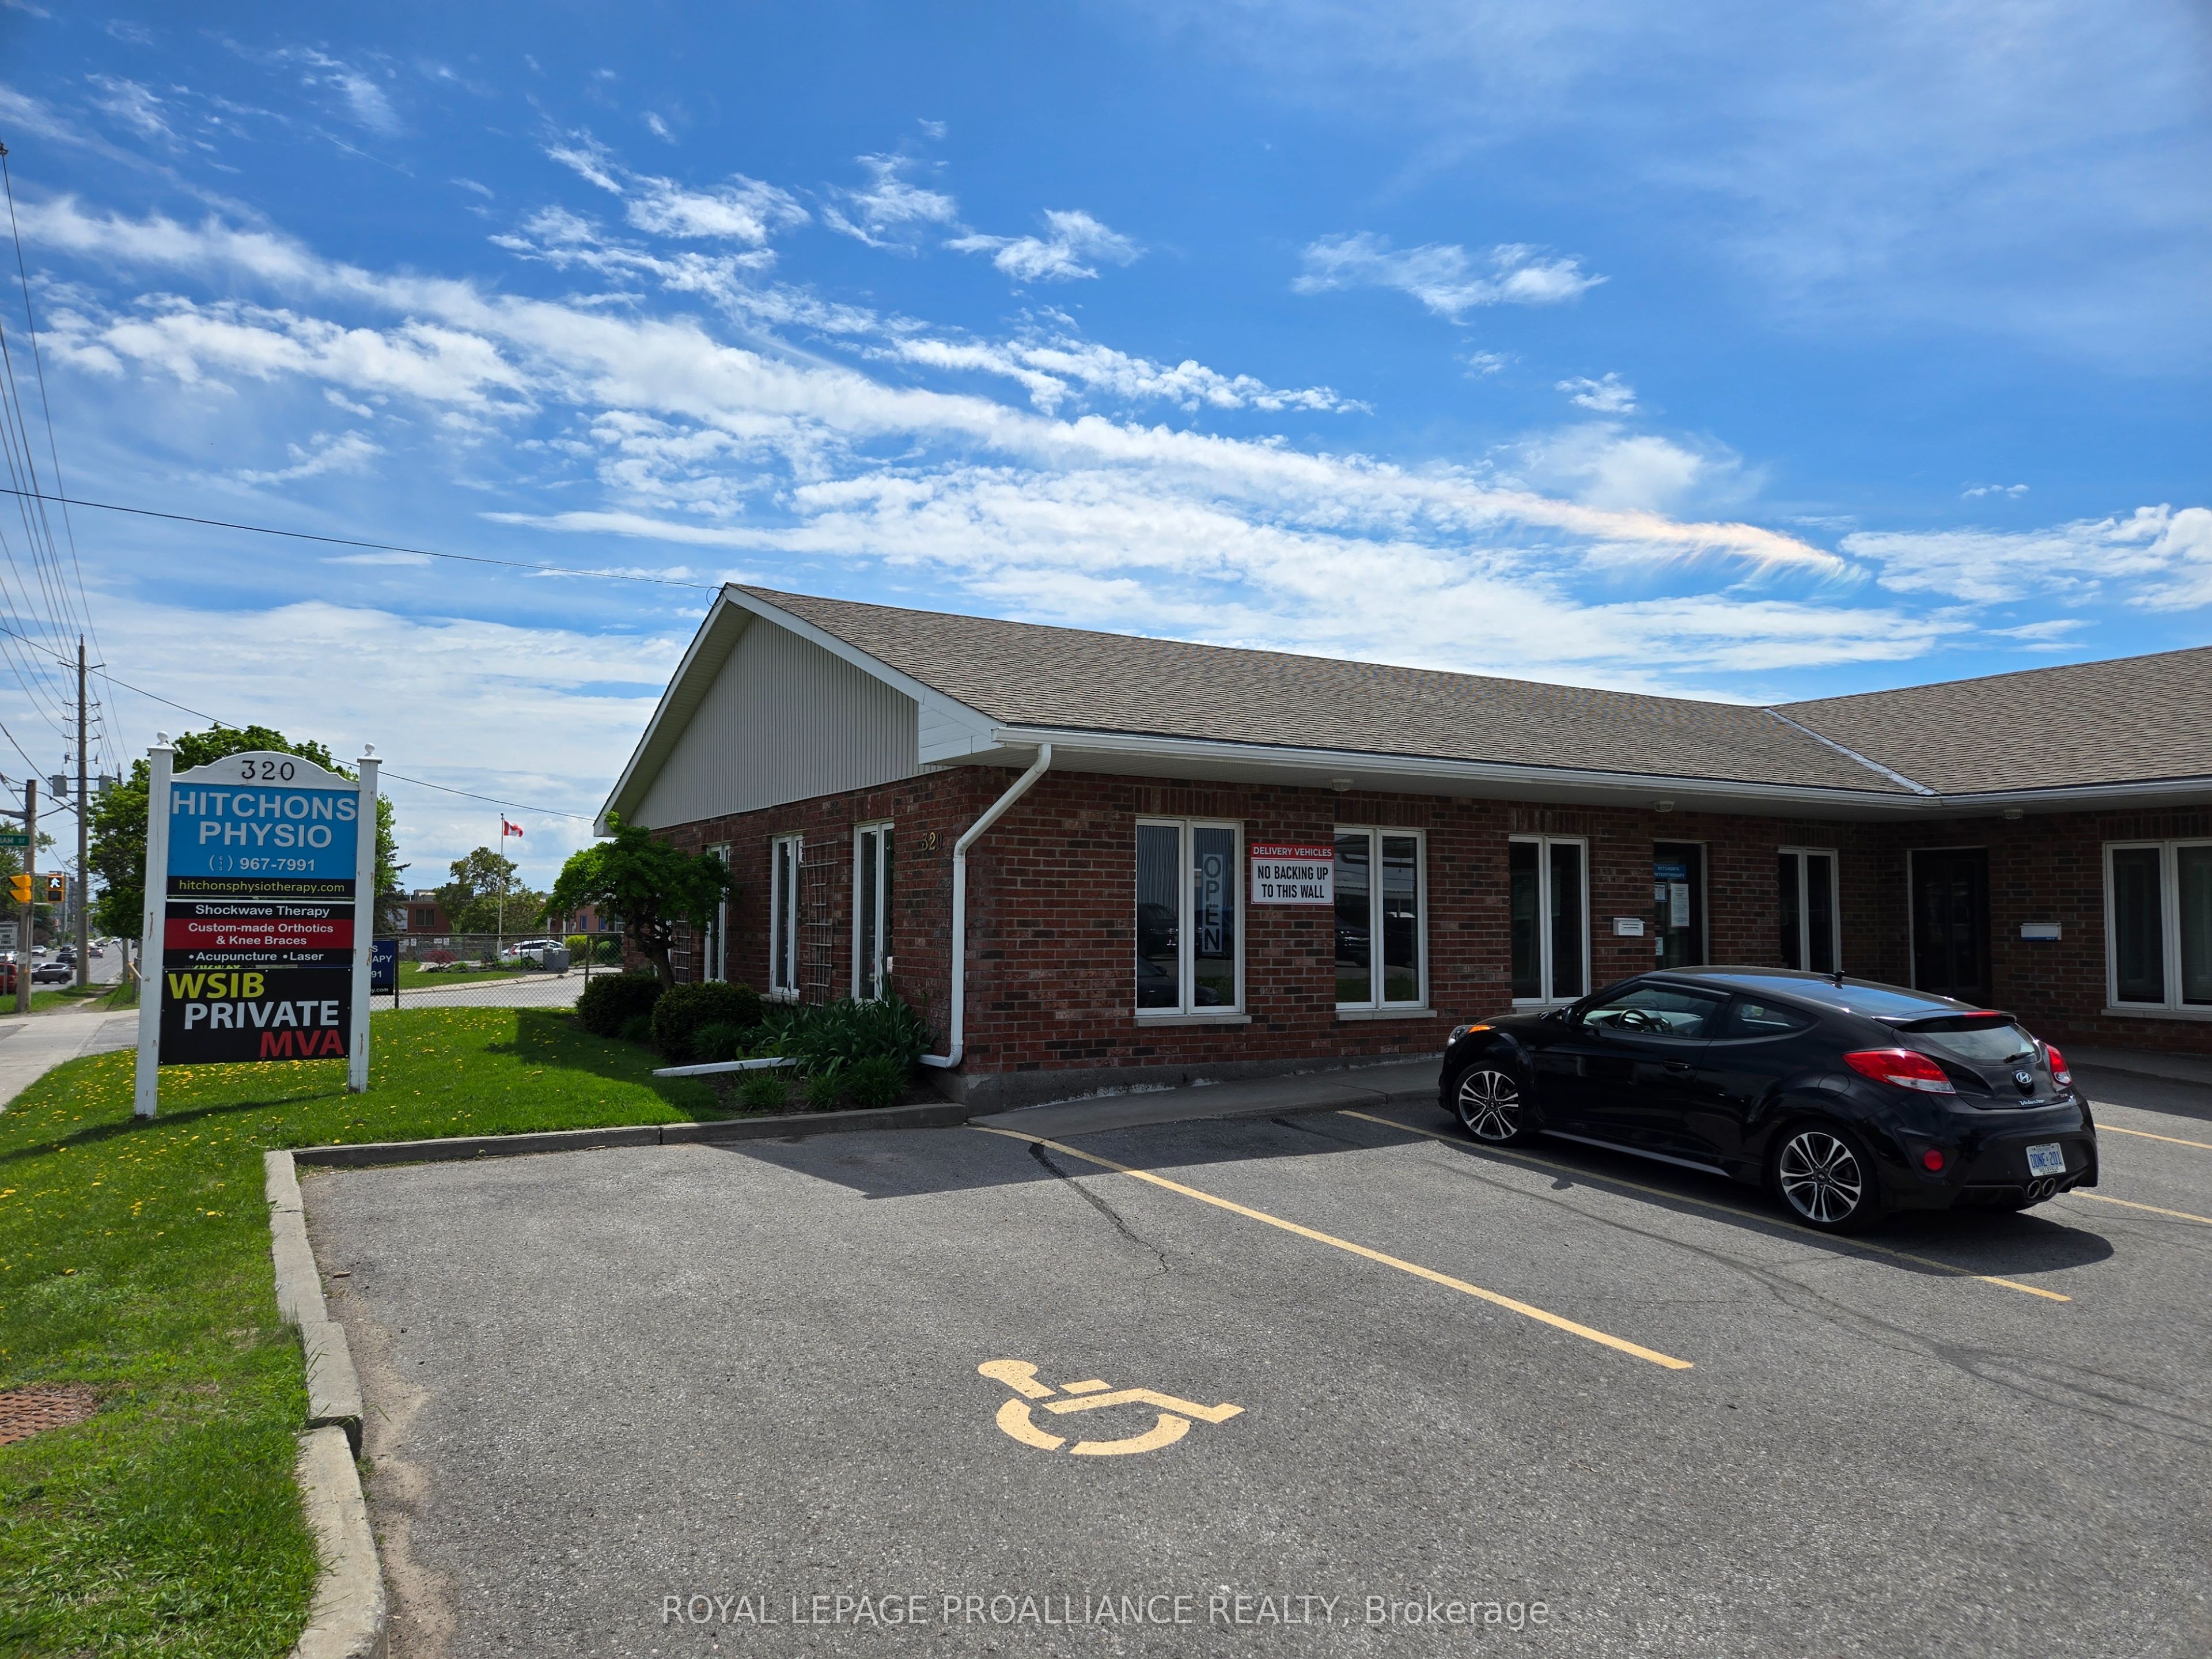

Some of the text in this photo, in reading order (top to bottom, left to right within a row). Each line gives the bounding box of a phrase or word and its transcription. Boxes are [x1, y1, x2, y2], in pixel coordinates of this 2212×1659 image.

[241, 760, 295, 781] 320
[173, 790, 356, 821] HITCHONS
[199, 821, 332, 848] PHYSIO
[922, 832, 942, 851] 320
[1253, 847, 1332, 857] DELIVERY VEHICLES
[240, 857, 315, 872] 967-7991
[1257, 865, 1328, 880] NO BACKING UP
[179, 879, 345, 893] hitchonsphysiotherapy.com
[1262, 884, 1324, 898] TO THIS WALL
[1204, 856, 1221, 950] OPEN
[195, 904, 330, 919] Shockwave Therapy
[188, 923, 334, 933] Custom-made Orthotics
[216, 935, 307, 946] & Knee Braces
[196, 951, 324, 964] Acupuncture Laser
[168, 972, 264, 999] WSIB
[184, 1000, 340, 1030] PRIVATE
[260, 1030, 344, 1058] MVA
